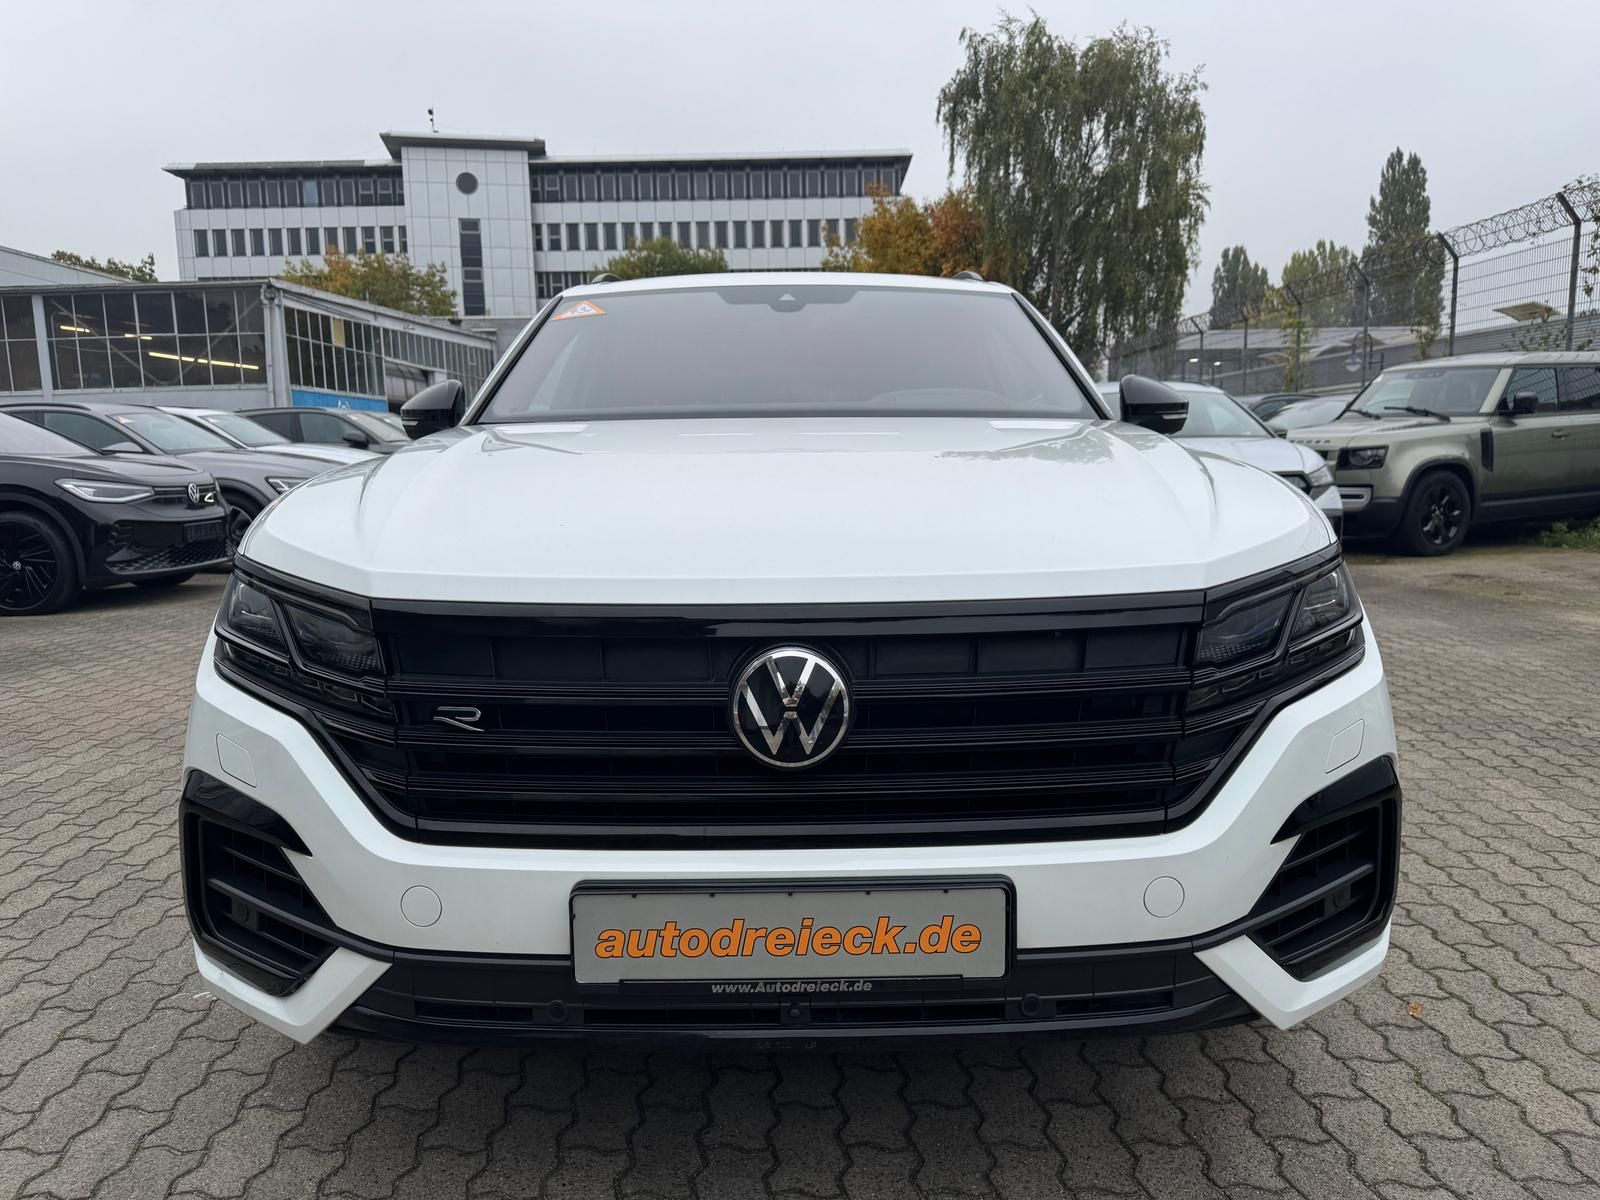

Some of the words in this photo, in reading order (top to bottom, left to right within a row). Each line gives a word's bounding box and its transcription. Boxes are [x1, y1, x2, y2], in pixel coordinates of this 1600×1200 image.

[433, 706, 485, 731] R
[594, 915, 982, 959] autodreieck.de
[711, 979, 873, 993] www.Autodreieck.de
